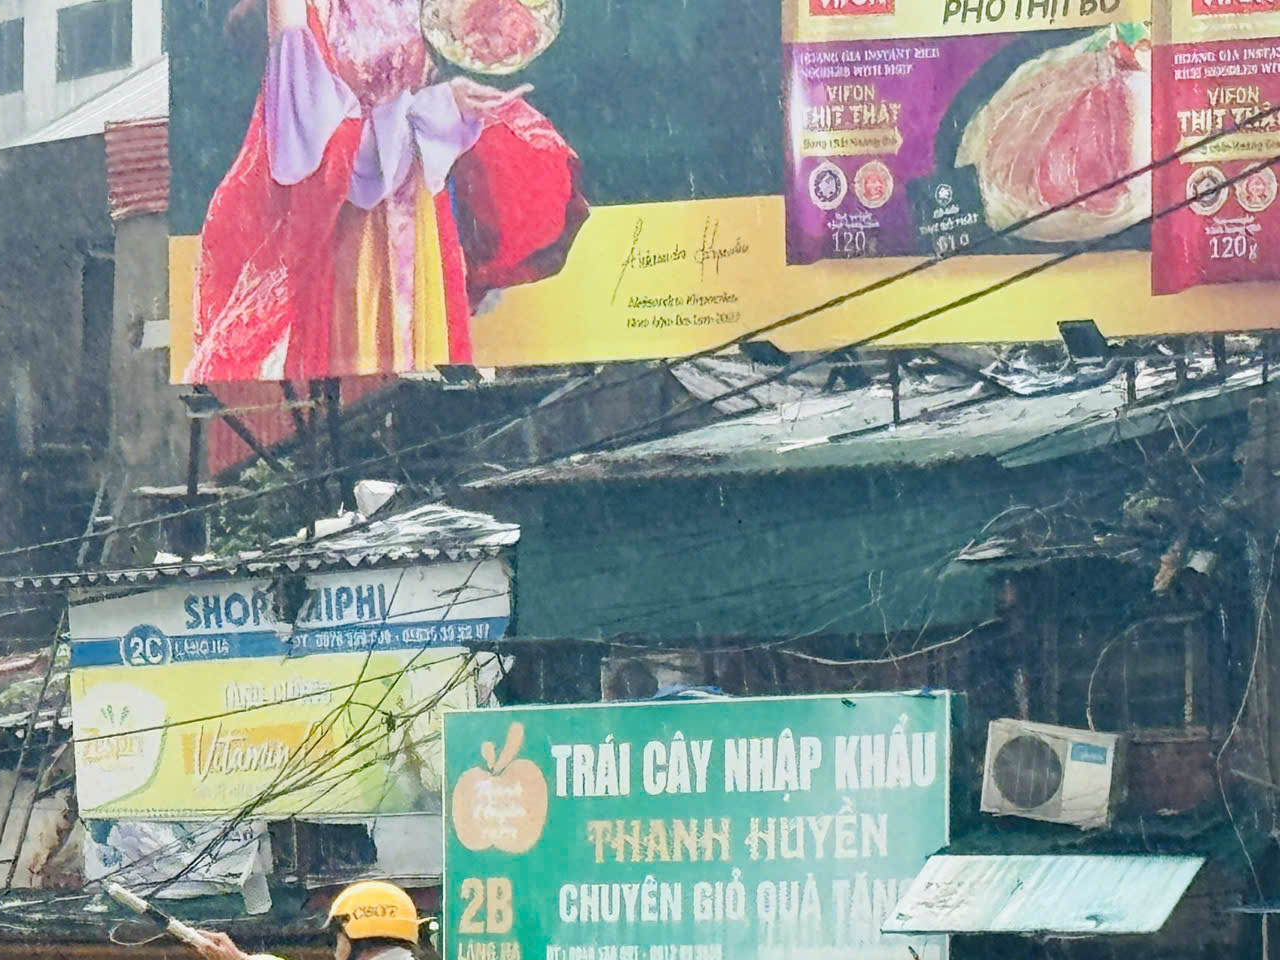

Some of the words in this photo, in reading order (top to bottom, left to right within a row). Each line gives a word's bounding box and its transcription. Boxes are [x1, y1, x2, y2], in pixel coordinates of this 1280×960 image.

[826, 85, 875, 102] VIFON
[1207, 85, 1259, 106] VIFON
[130, 636, 162, 665] 2C
[551, 732, 631, 797] TRÁI
[642, 730, 714, 796] CÂY
[724, 727, 823, 802] NHẬP
[834, 712, 938, 791] KHẨU
[587, 816, 731, 864] THANH
[744, 797, 888, 862] HUYỀN
[459, 877, 513, 934] 2B
[558, 874, 683, 924] CHUYÊN
